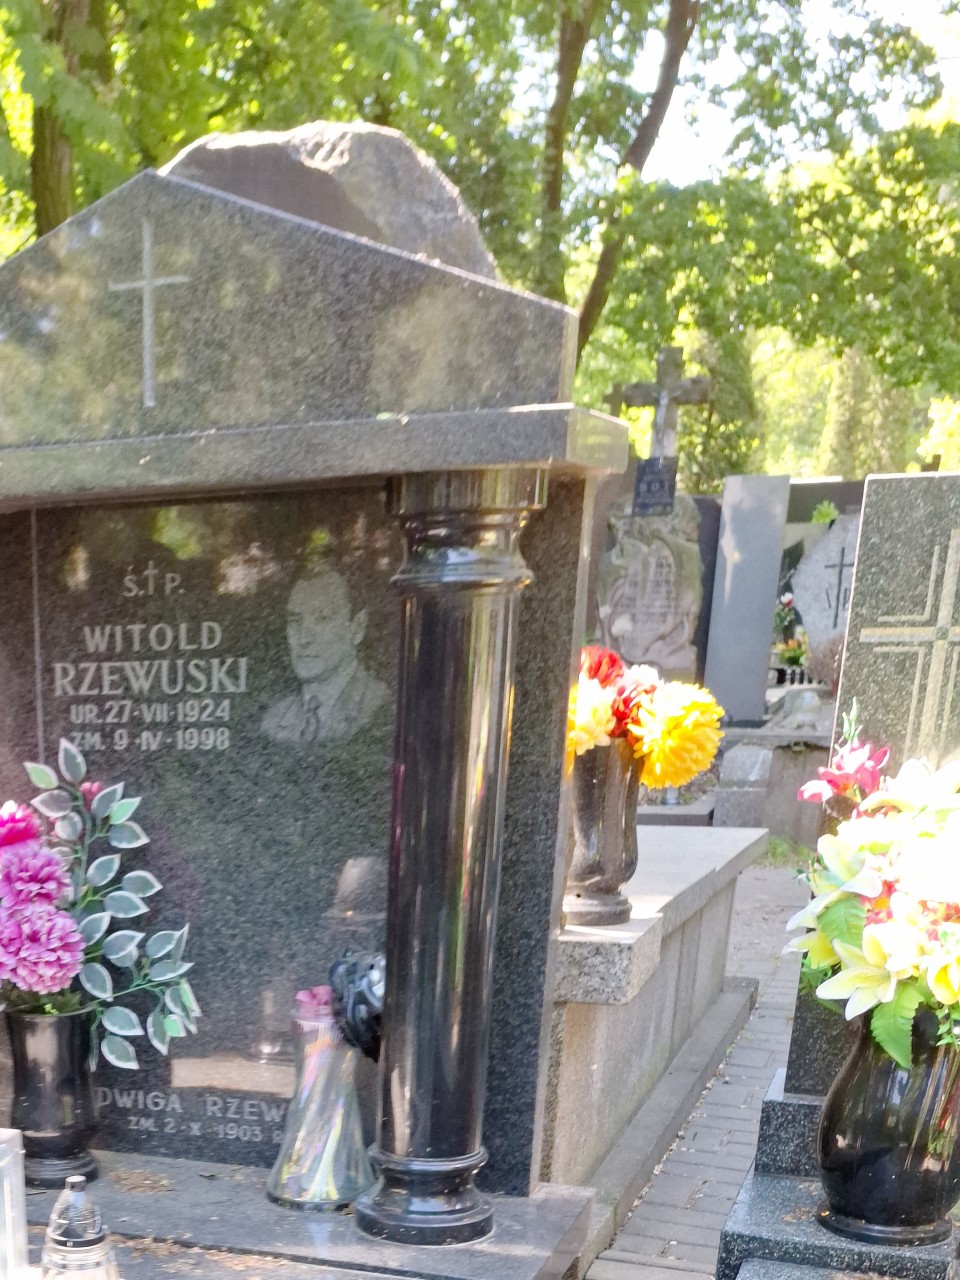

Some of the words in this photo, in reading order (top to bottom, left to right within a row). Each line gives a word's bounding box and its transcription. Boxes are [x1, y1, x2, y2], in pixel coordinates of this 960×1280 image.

[83, 620, 223, 654] WITOLD
[52, 656, 249, 697] RZEWUSKI
[92, 1086, 184, 1114] DWIGA
[205, 1096, 287, 1123] RZEW
